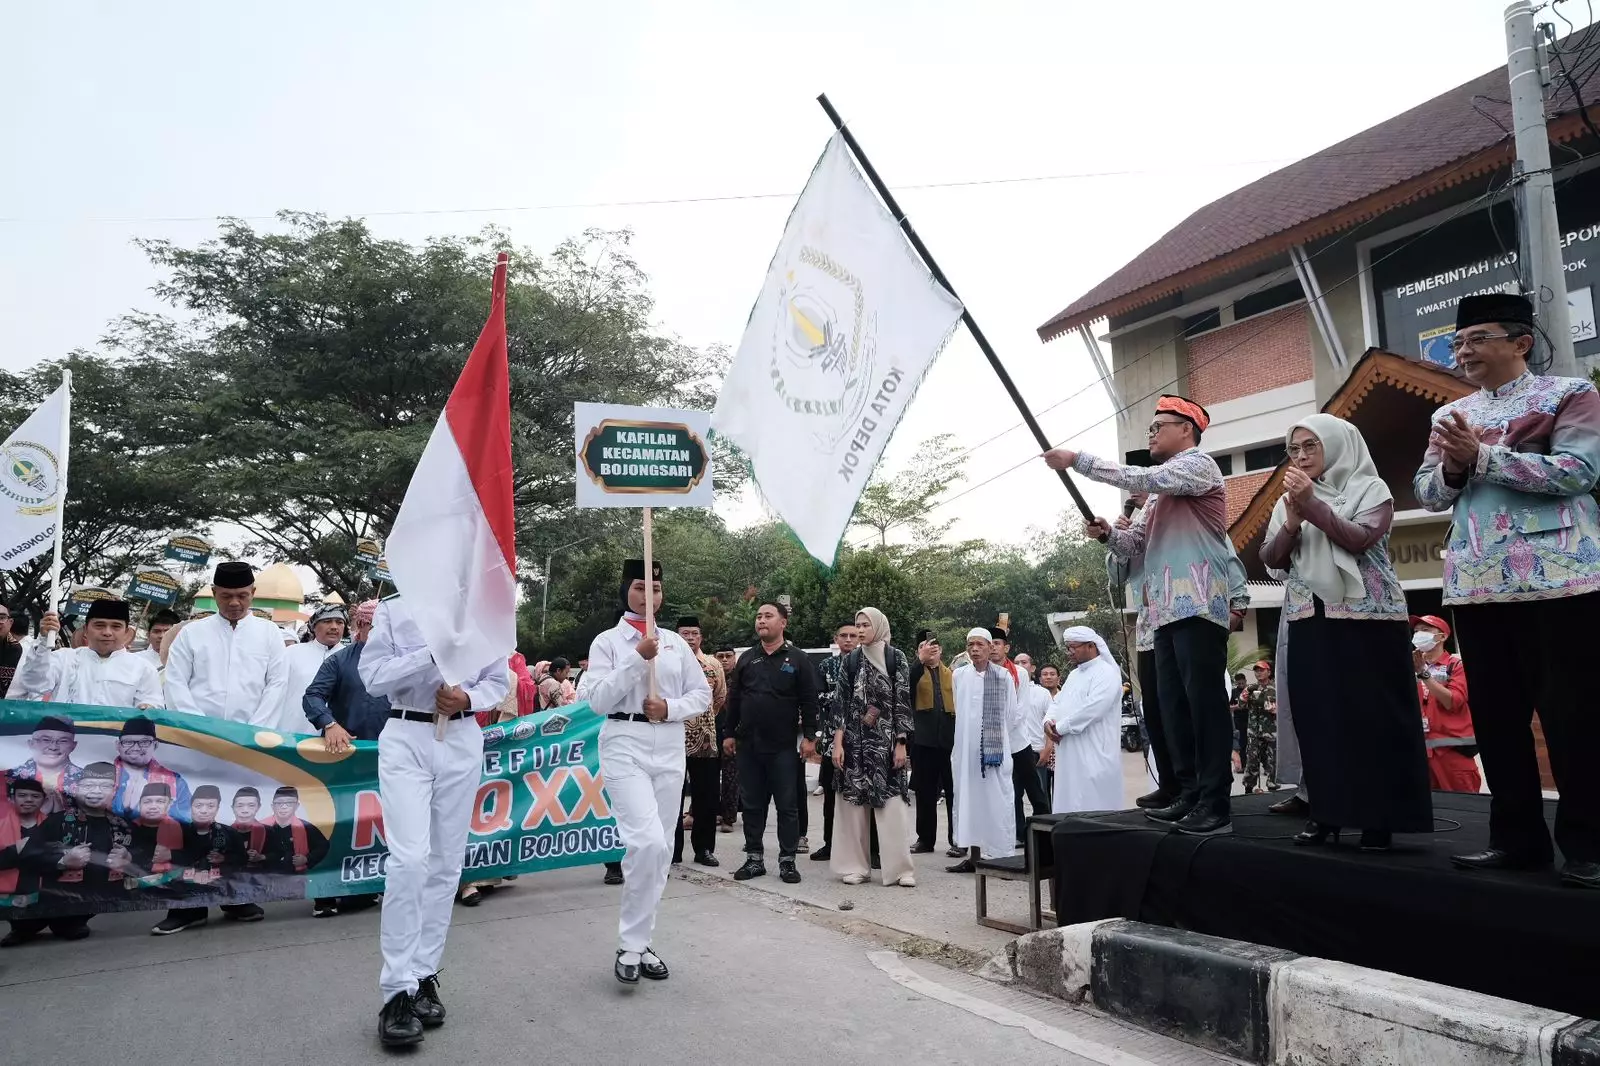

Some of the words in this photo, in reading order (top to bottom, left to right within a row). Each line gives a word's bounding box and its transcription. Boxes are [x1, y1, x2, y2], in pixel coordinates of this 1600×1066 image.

[1396, 260, 1490, 299] PEMERINTAH
[1493, 251, 1518, 269] KO
[616, 430, 677, 446] KAFILAH
[602, 447, 690, 462] KECAMATAN
[600, 463, 693, 477] BOJONGSARI
[140, 583, 168, 594] KELURAHAN
[483, 741, 585, 776] EFILE
[519, 824, 627, 862] BOJONGS
